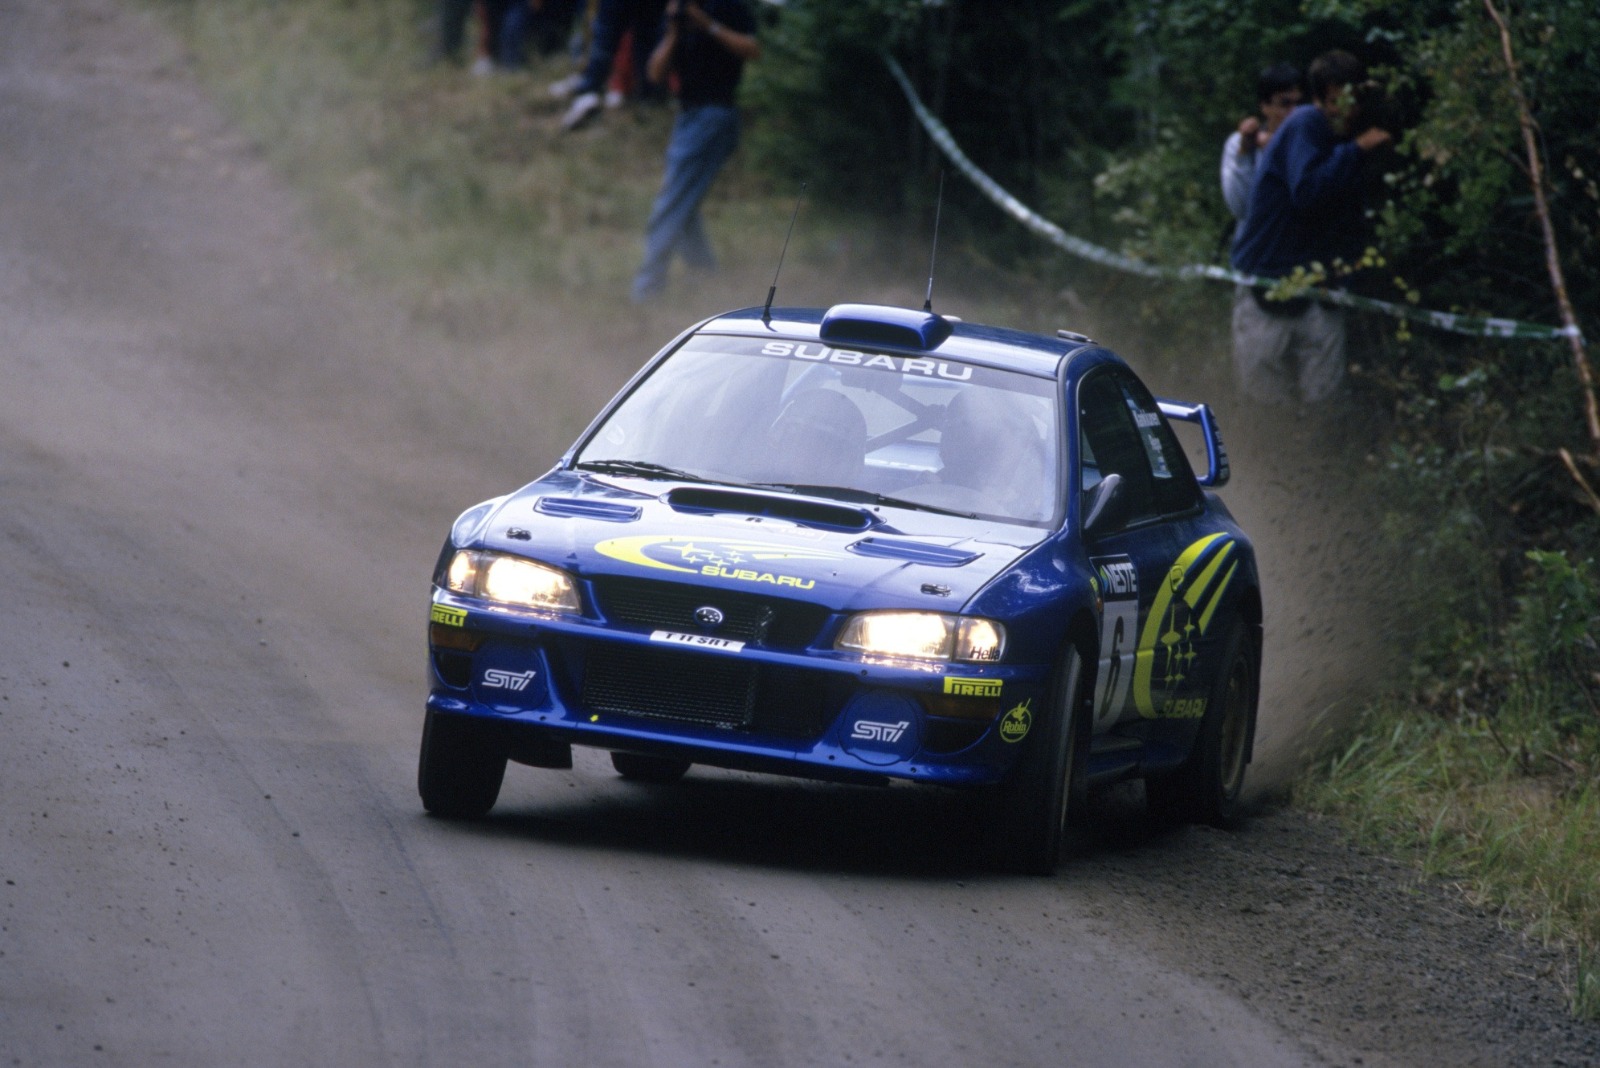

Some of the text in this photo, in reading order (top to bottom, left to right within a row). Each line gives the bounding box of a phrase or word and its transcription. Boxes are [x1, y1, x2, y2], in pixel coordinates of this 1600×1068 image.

[761, 341, 973, 381] SUBARU
[701, 564, 815, 590] SUBARU
[1101, 562, 1137, 593] NESTE
[430, 603, 468, 627] PRELLI
[968, 645, 1001, 661] Hella
[1099, 615, 1125, 720] 6
[943, 676, 1003, 697] PIRELLI
[1002, 720, 1027, 734] Robin
